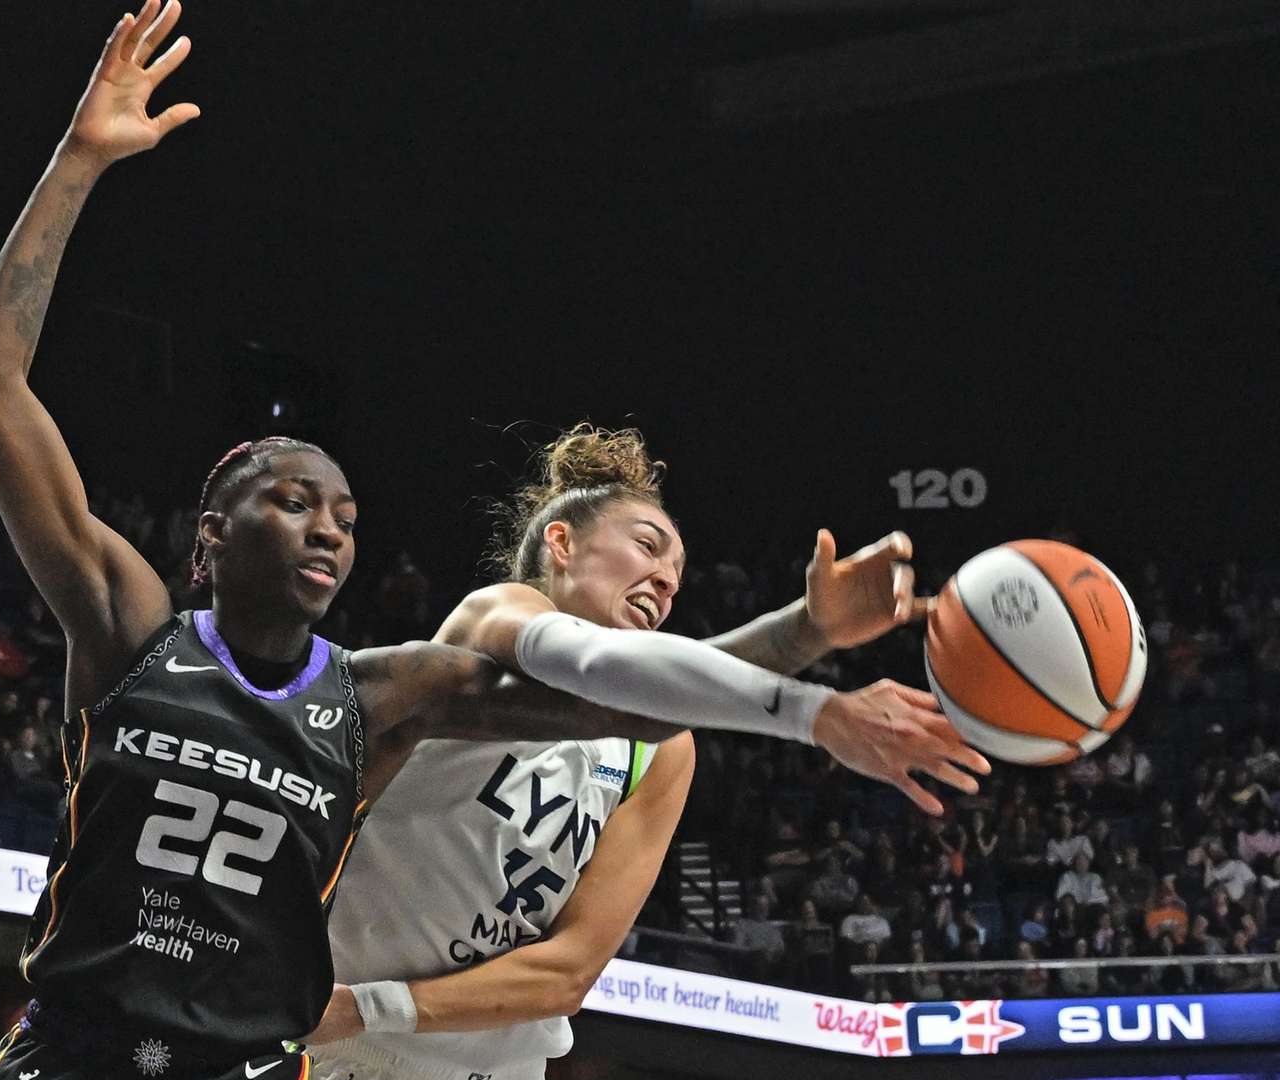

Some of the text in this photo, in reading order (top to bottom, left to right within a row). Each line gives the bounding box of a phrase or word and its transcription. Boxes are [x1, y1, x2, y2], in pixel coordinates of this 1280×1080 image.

[889, 468, 987, 509] 120
[114, 727, 336, 820] KEESUSK
[135, 778, 288, 896] 22
[141, 886, 181, 910] Yale
[137, 908, 240, 954] NewHaven
[618, 980, 641, 1000] up
[644, 976, 667, 1002] for
[673, 982, 721, 1011] better
[724, 991, 781, 1022] health!
[1058, 1001, 1206, 1044] SUN
